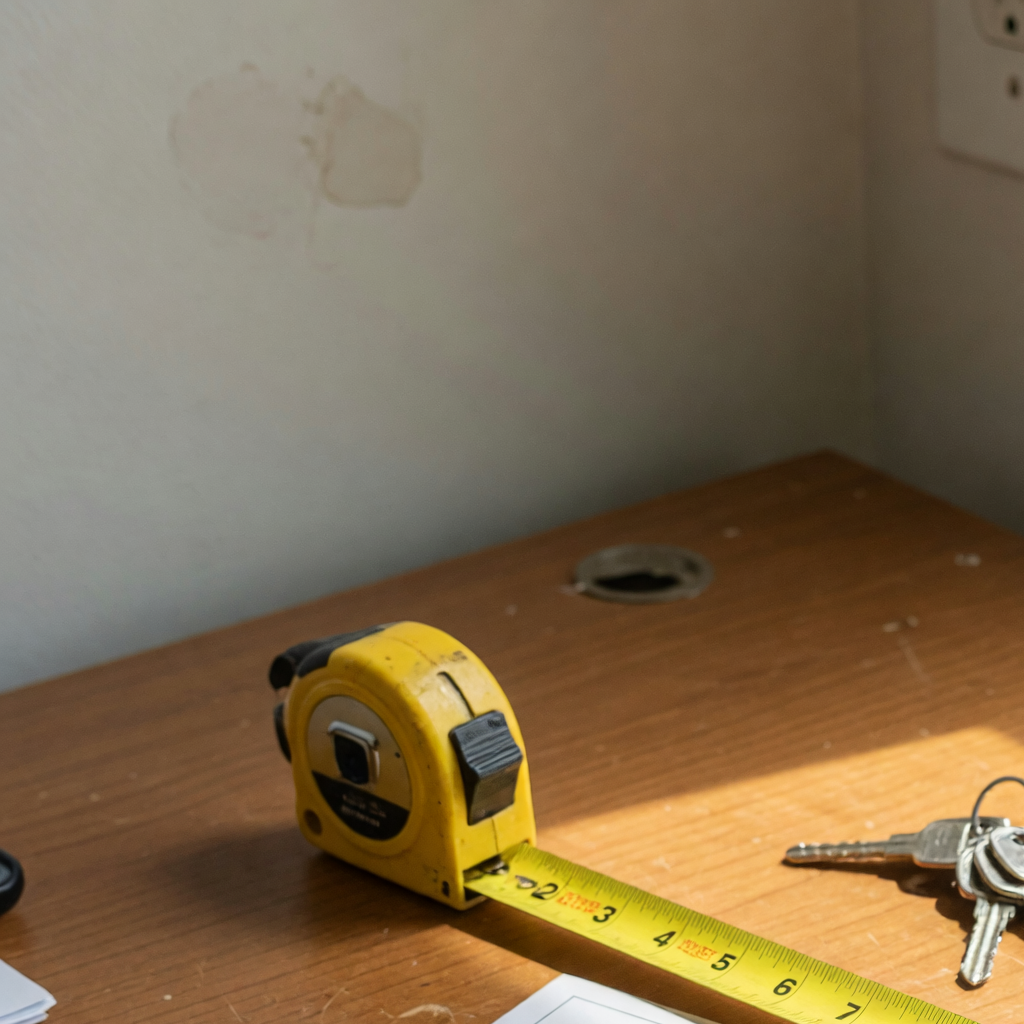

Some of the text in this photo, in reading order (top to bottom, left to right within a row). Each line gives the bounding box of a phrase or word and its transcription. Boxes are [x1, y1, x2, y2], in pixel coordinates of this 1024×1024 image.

[592, 906, 617, 924] 3
[652, 930, 677, 948] 4
[710, 953, 737, 972] 5
[772, 978, 798, 997] 6
[834, 1002, 862, 1022] 7
